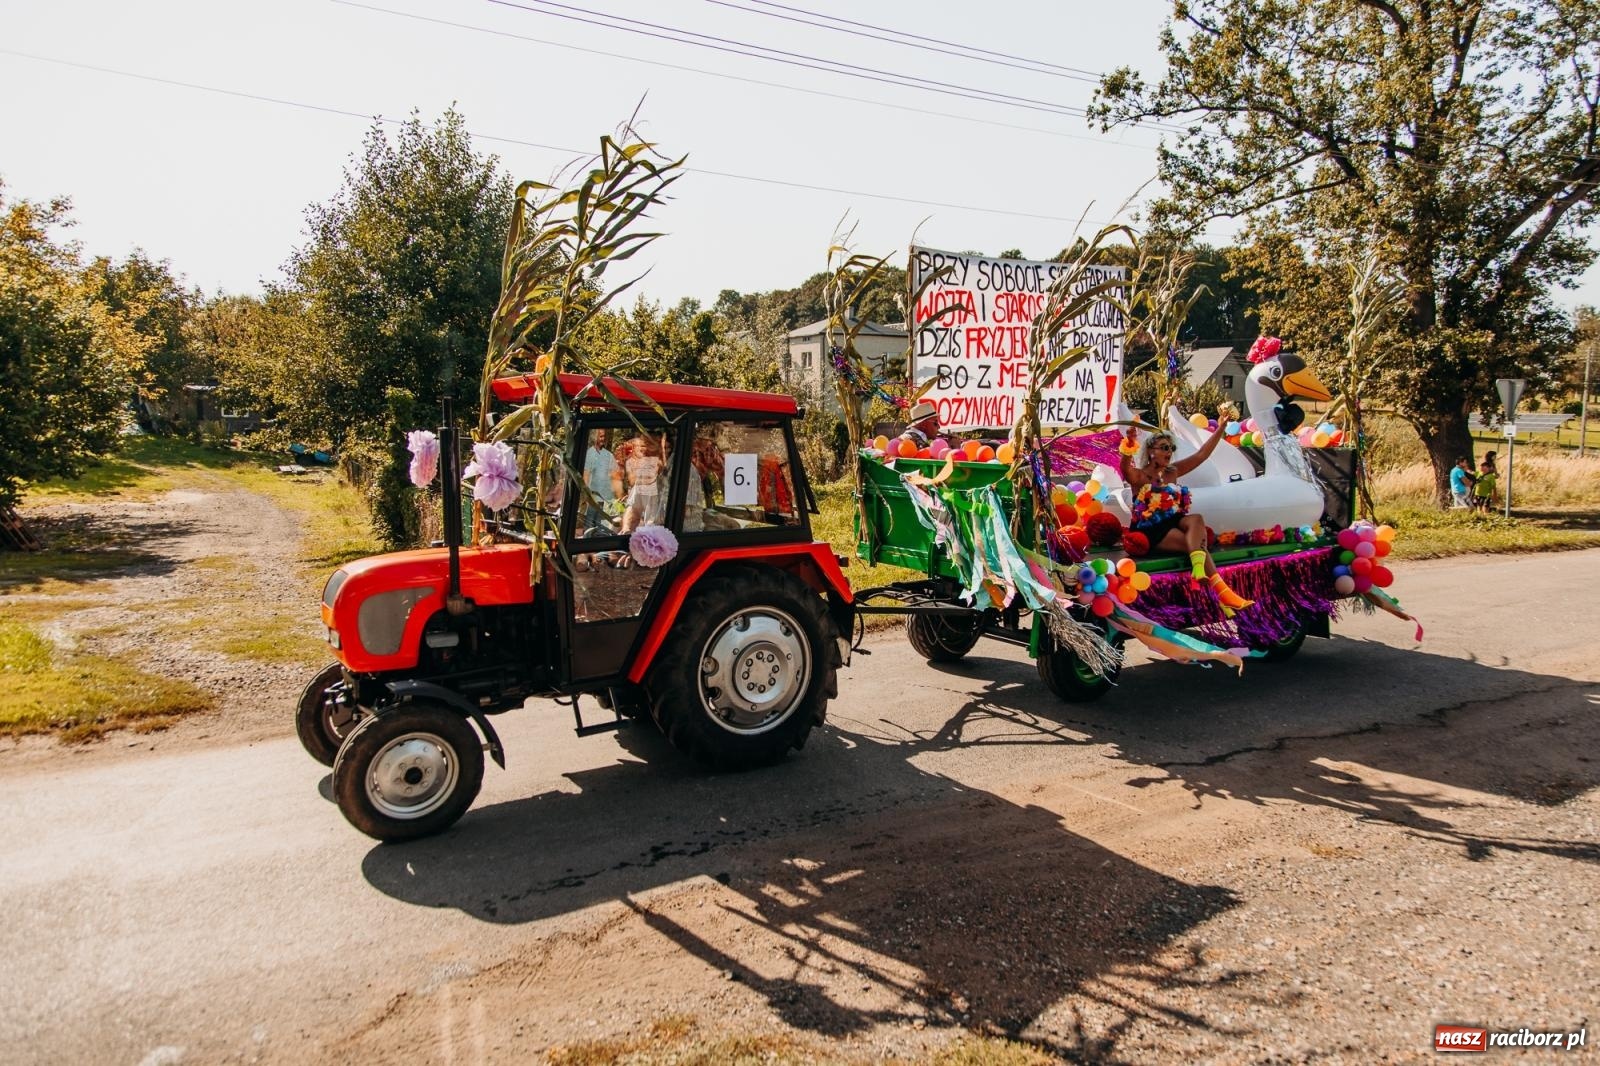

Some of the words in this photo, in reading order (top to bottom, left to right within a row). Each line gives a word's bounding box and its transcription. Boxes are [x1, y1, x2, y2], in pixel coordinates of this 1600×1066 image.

[917, 251, 969, 286] PRZY
[977, 260, 1045, 294] SOBOCIE
[916, 285, 978, 327] WÓJTA
[981, 293, 986, 322] I
[917, 325, 962, 359] DZIŚ
[937, 364, 969, 390] BO
[977, 365, 992, 389] Z
[1075, 368, 1095, 393] NA
[733, 466, 751, 486] 6.
